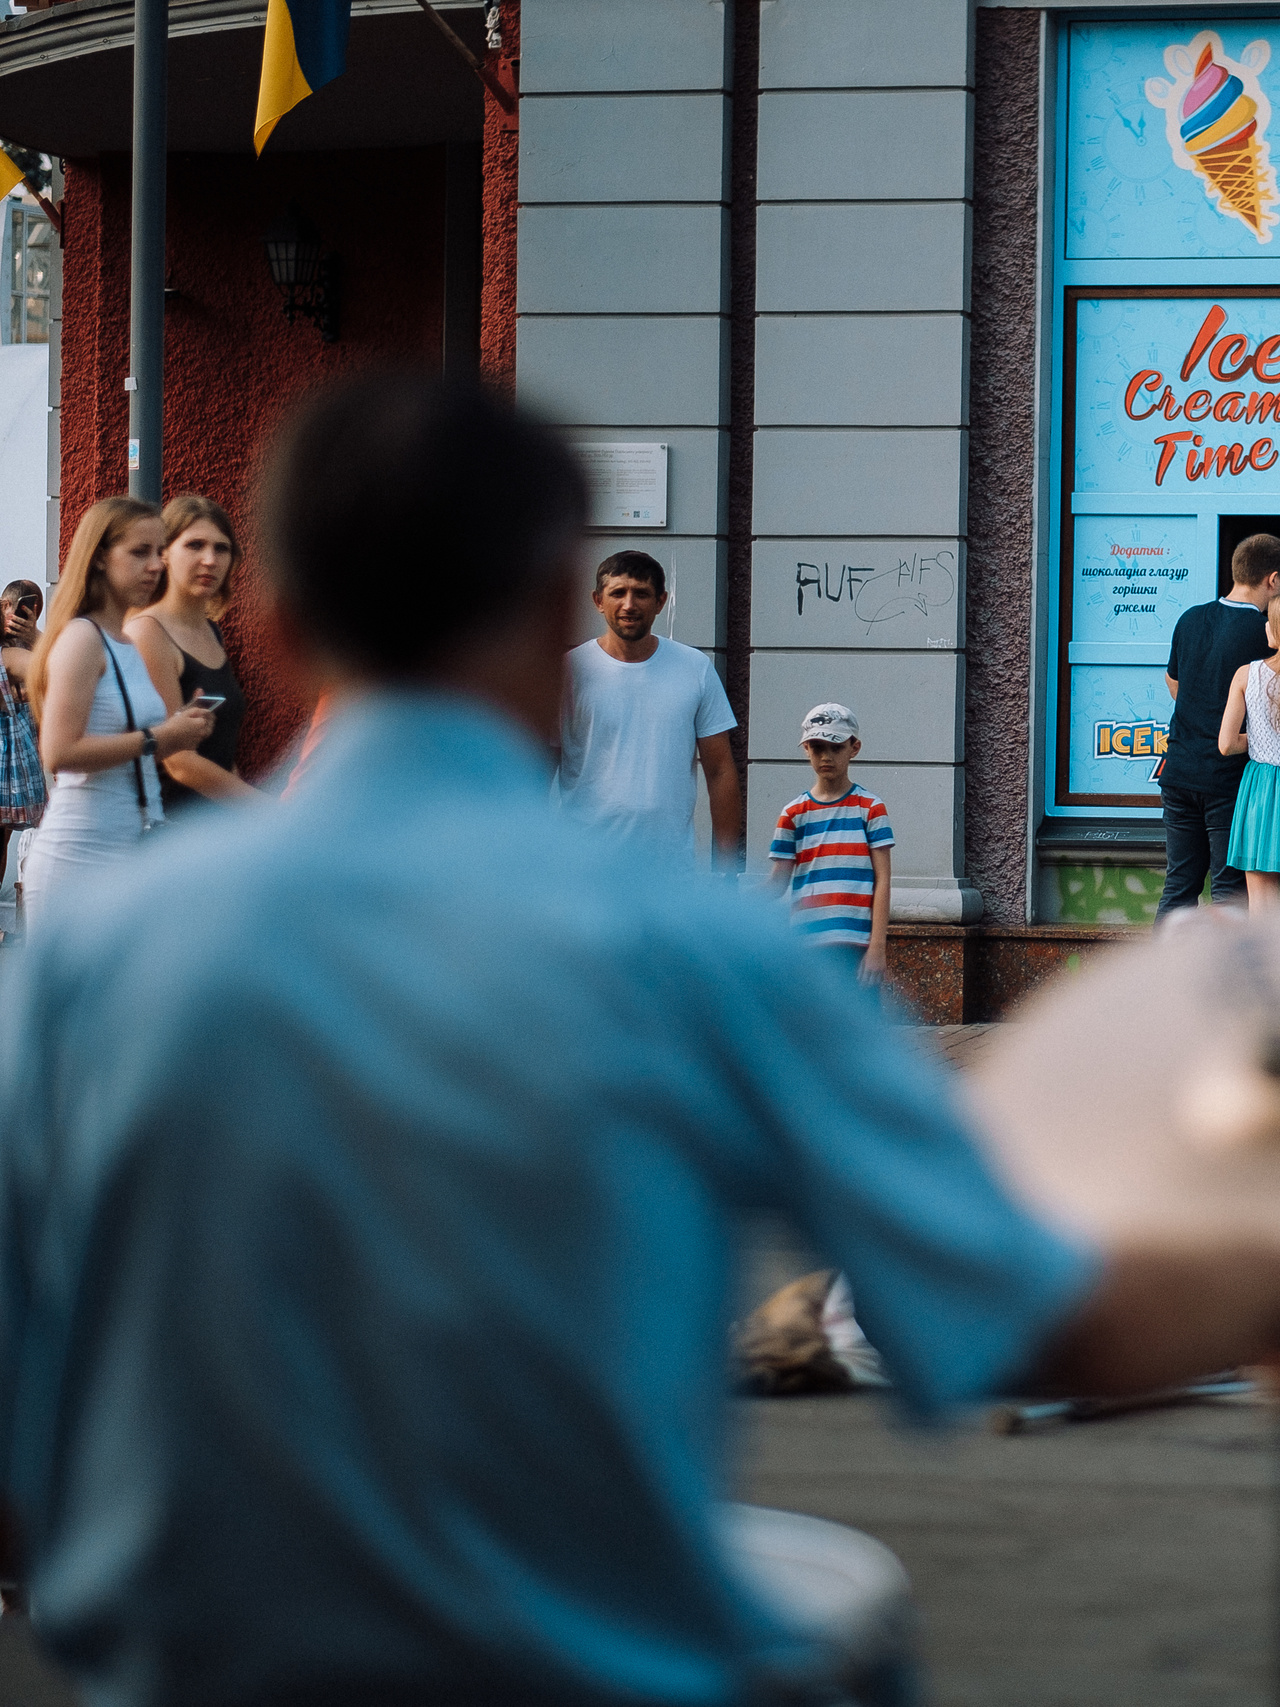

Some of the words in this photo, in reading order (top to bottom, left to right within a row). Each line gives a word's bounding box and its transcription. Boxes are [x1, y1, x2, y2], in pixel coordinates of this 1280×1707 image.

[1154, 430, 1278, 487] Time
[1110, 544, 1163, 558] Додатки
[1082, 568, 1146, 580] шоколадна
[1149, 568, 1188, 580] глазур
[1112, 583, 1157, 597] горішки
[1114, 604, 1155, 615] джеми
